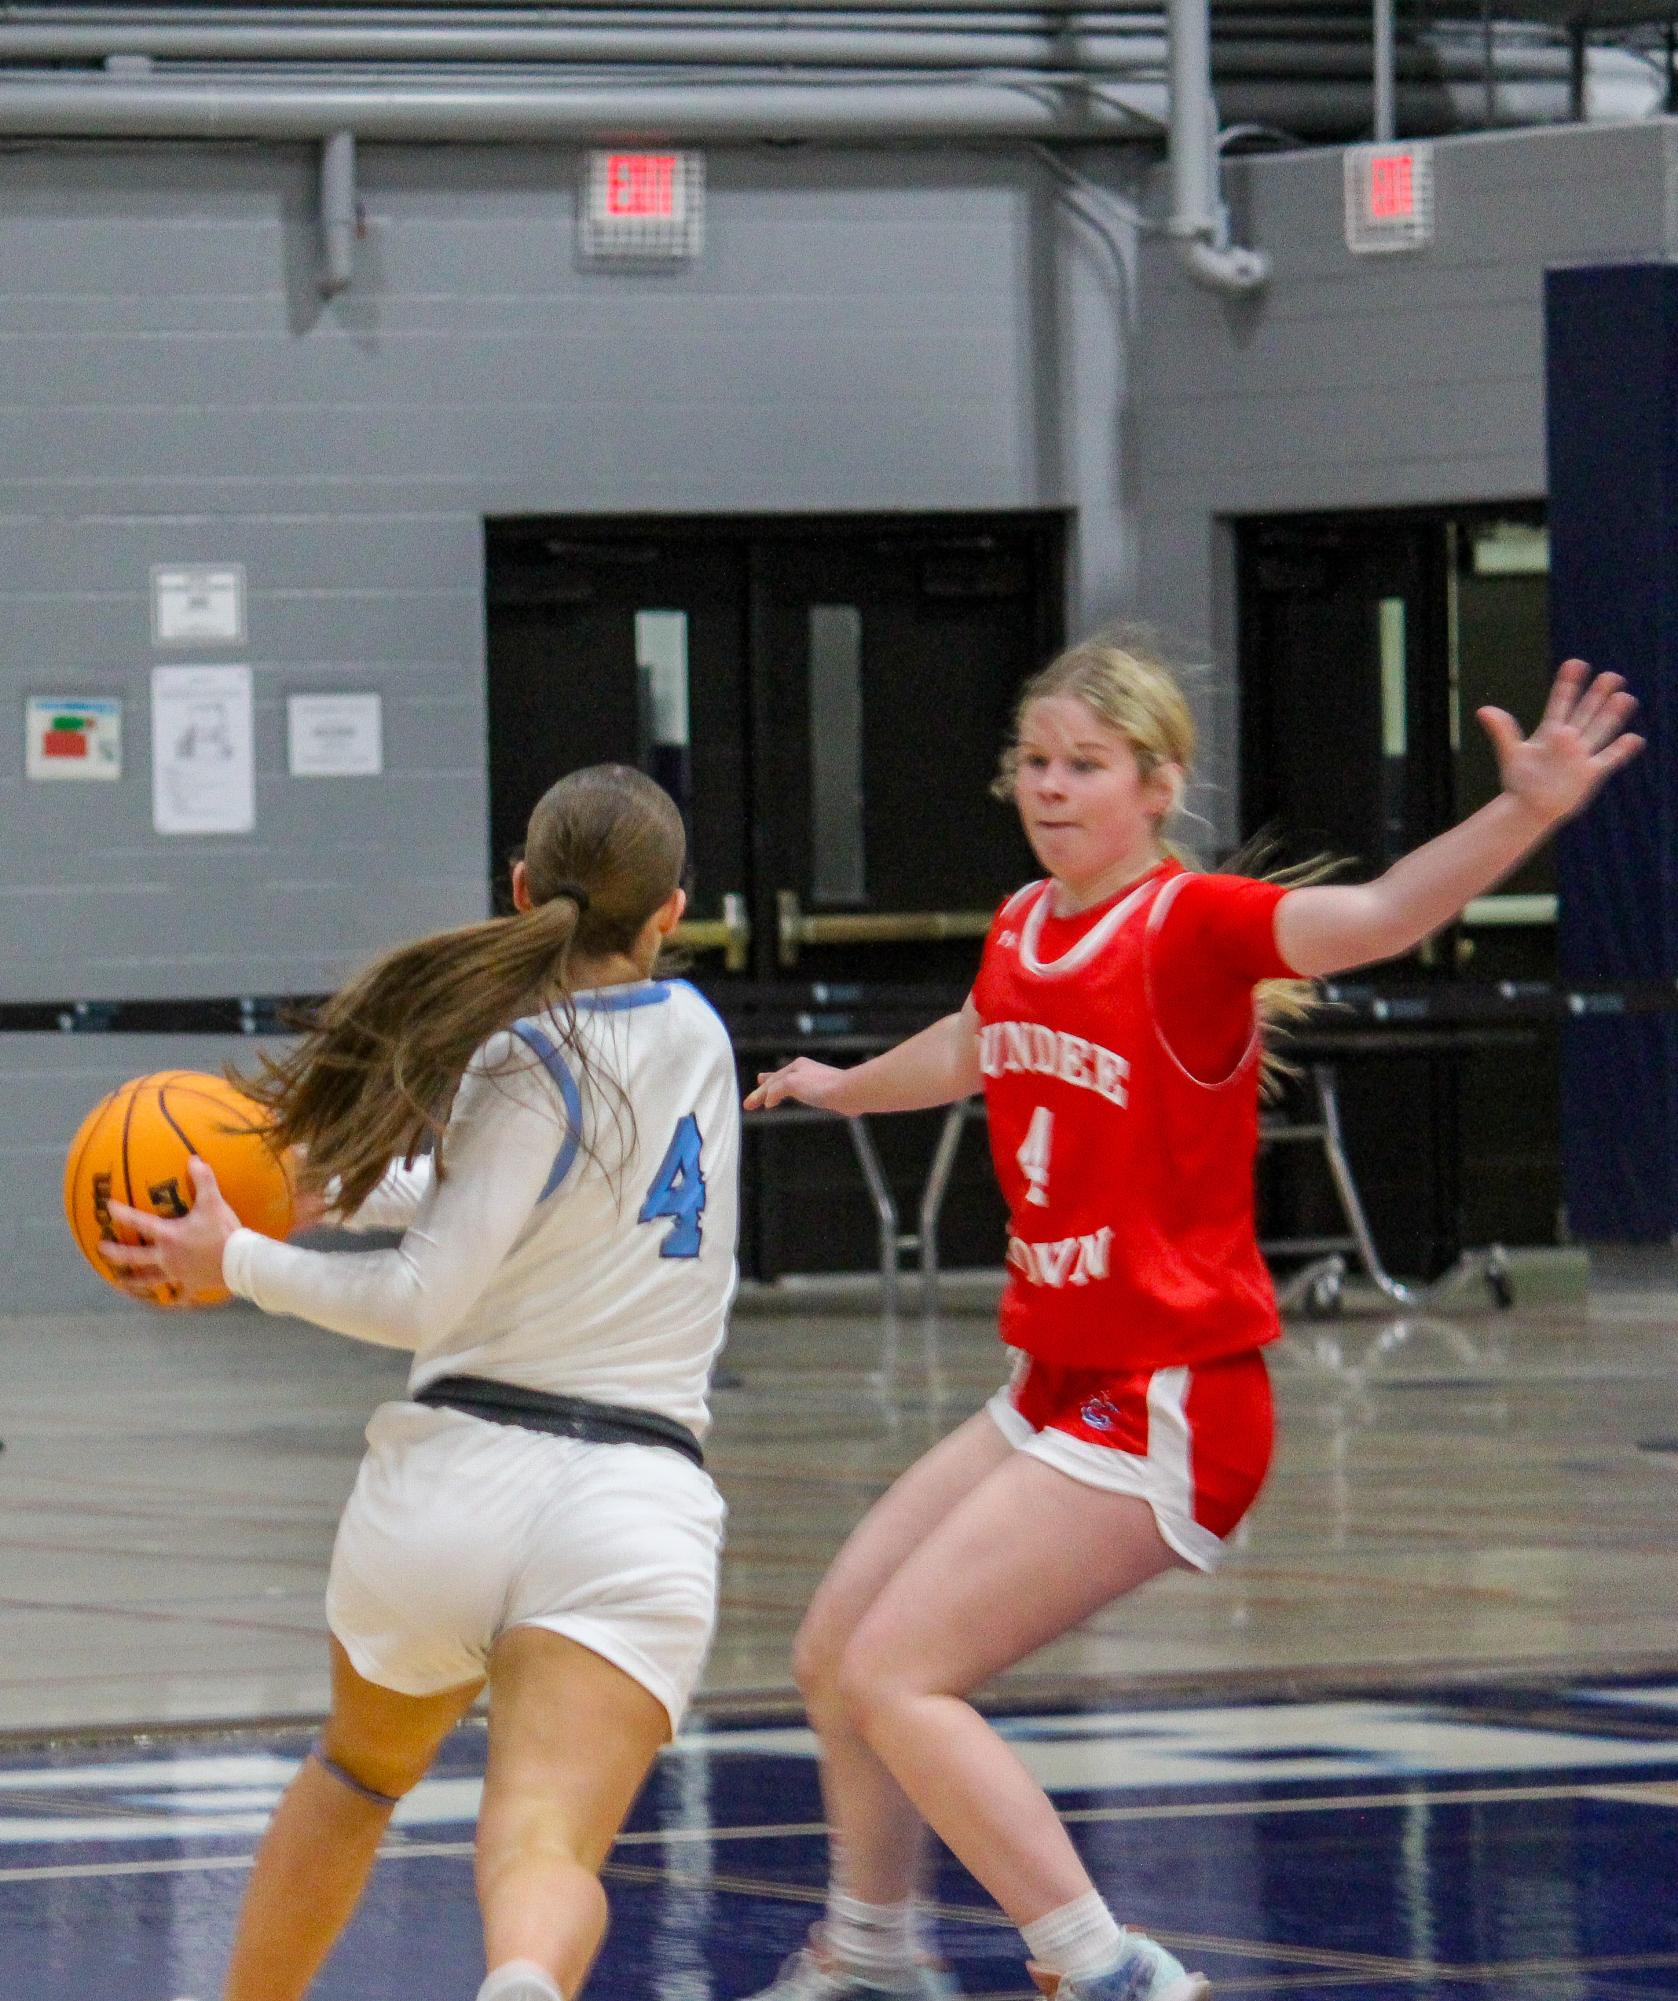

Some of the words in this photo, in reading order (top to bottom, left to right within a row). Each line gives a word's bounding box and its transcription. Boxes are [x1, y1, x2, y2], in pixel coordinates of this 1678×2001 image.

[607, 154, 677, 217] EXIT
[979, 1020, 1131, 1110] UNDEE
[637, 1111, 707, 1259] 4
[1014, 1105, 1056, 1209] 4
[1005, 1225, 1116, 1288] OWN
